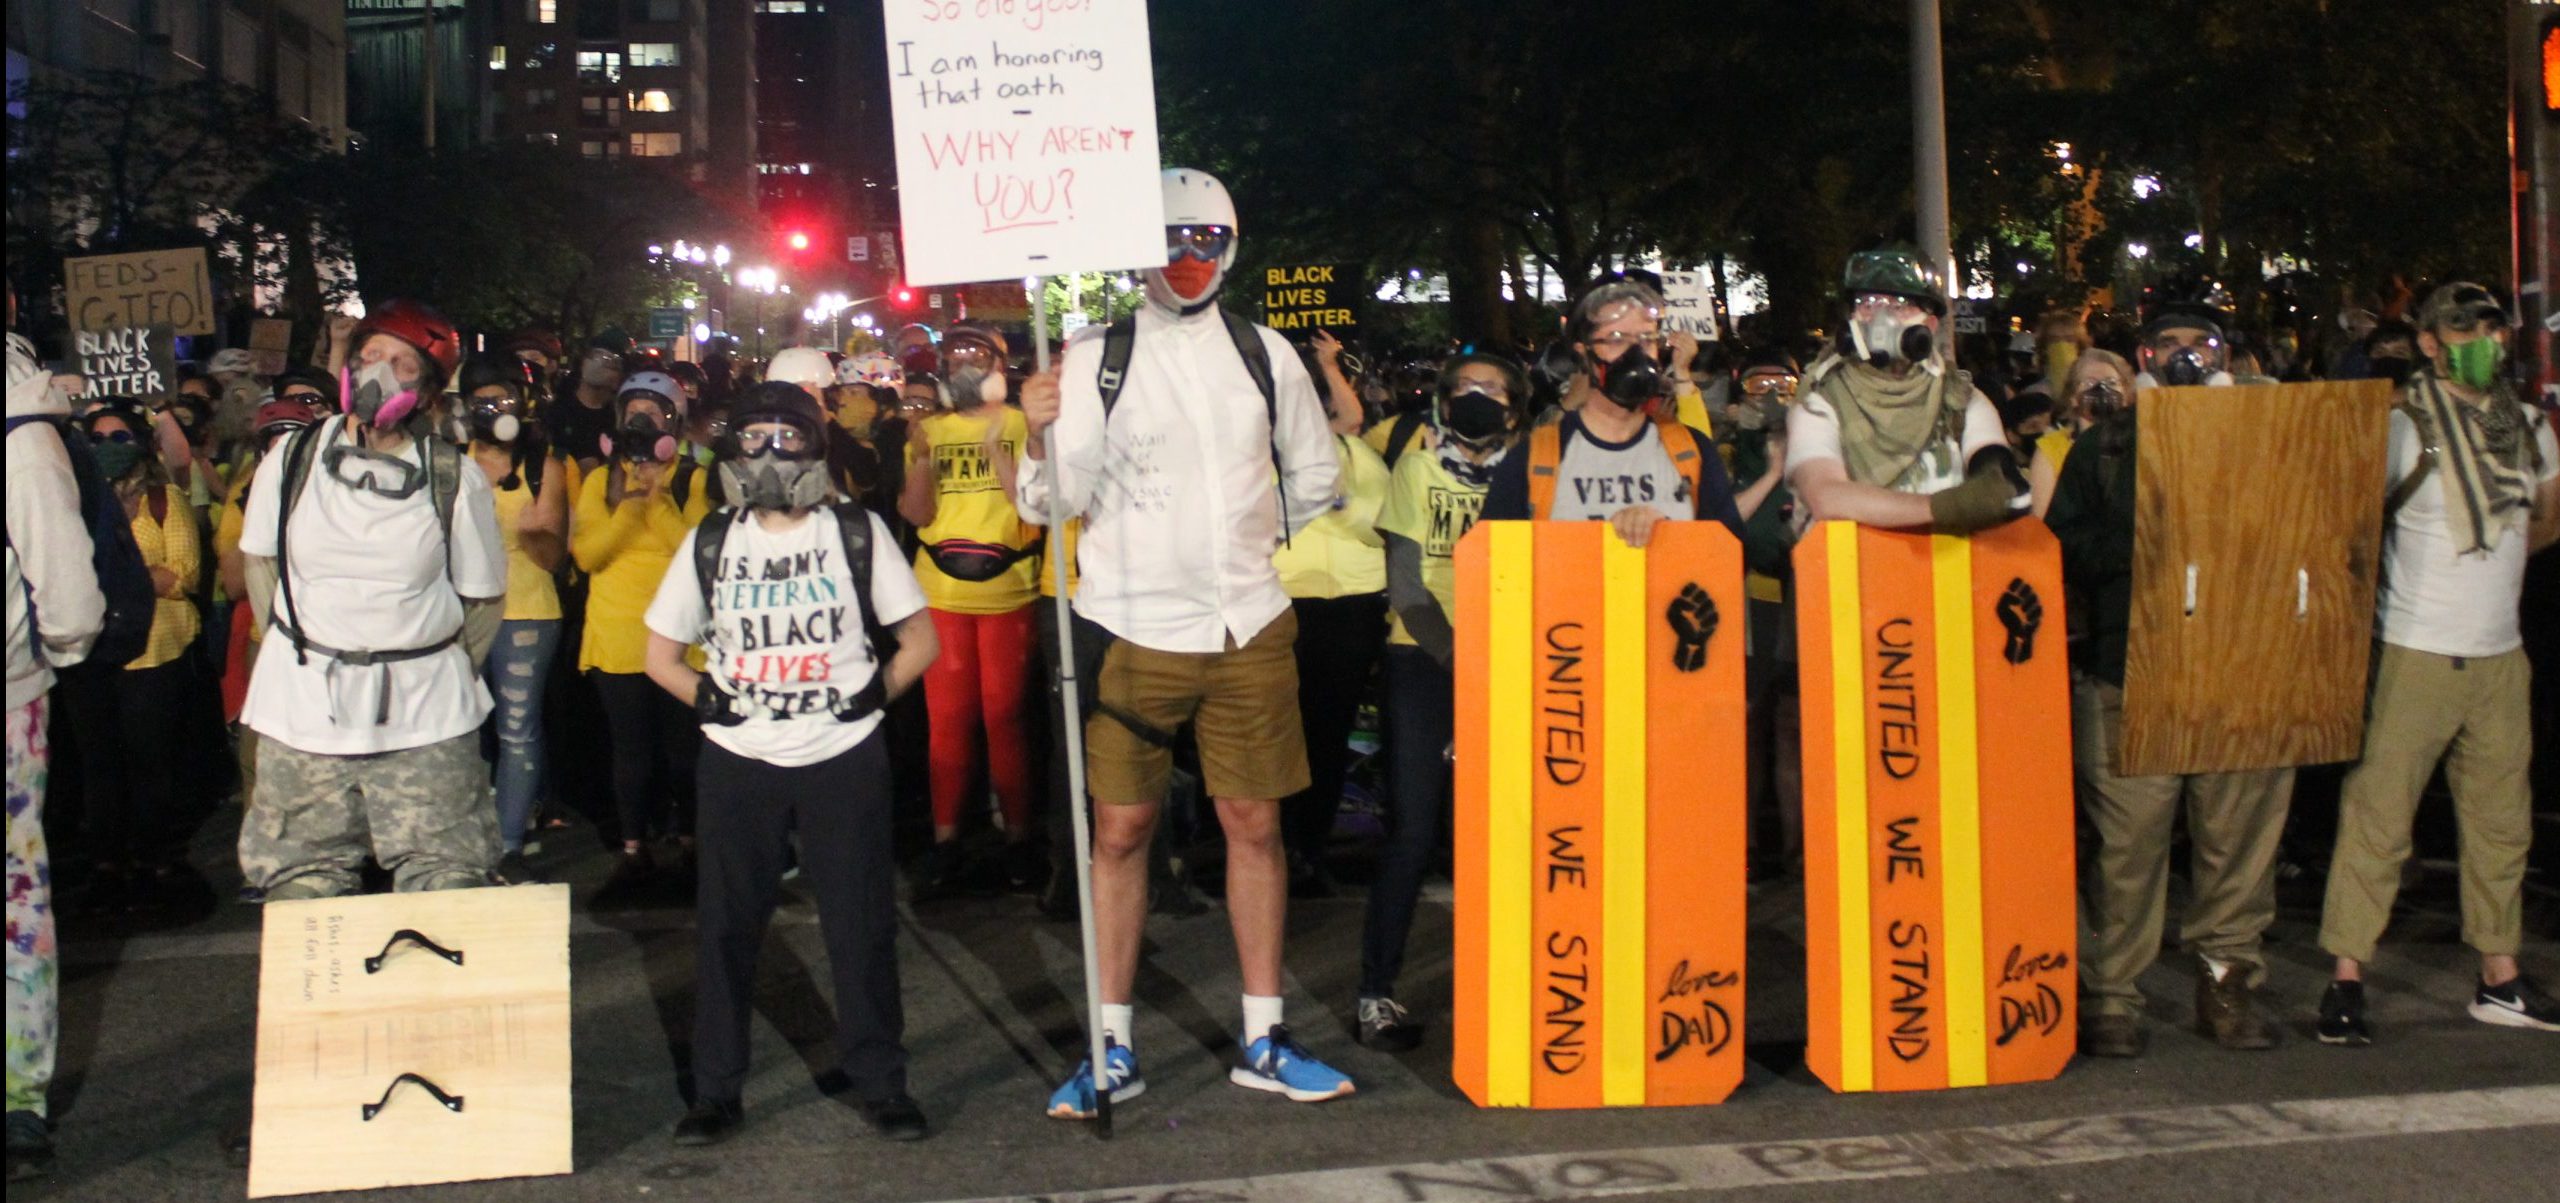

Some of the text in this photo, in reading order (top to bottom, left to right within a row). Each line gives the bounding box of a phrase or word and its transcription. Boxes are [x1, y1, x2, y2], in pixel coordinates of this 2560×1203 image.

[898, 40, 1103, 76] I am honoring
[918, 73, 1064, 108] that oath
[922, 125, 1135, 170] WHY AREN'T
[973, 167, 1075, 228] YOU?
[1266, 265, 1334, 286] BLACK
[1265, 288, 1327, 308] LIVES
[1267, 308, 1357, 329] MATTER.
[76, 327, 150, 356] BLACK
[81, 352, 152, 376] LIVES
[70, 370, 165, 400] ATTER
[1573, 473, 1656, 505] VETS
[716, 576, 838, 611] VETERAN
[740, 606, 846, 651] BLACK
[732, 652, 832, 685] LIVES
[1542, 622, 1588, 1076] UNITED WE STAND
[1876, 617, 1930, 1062] UNITED WE STAND
[1655, 1000, 1731, 1062] DAD
[1995, 983, 2062, 1048] DAD
